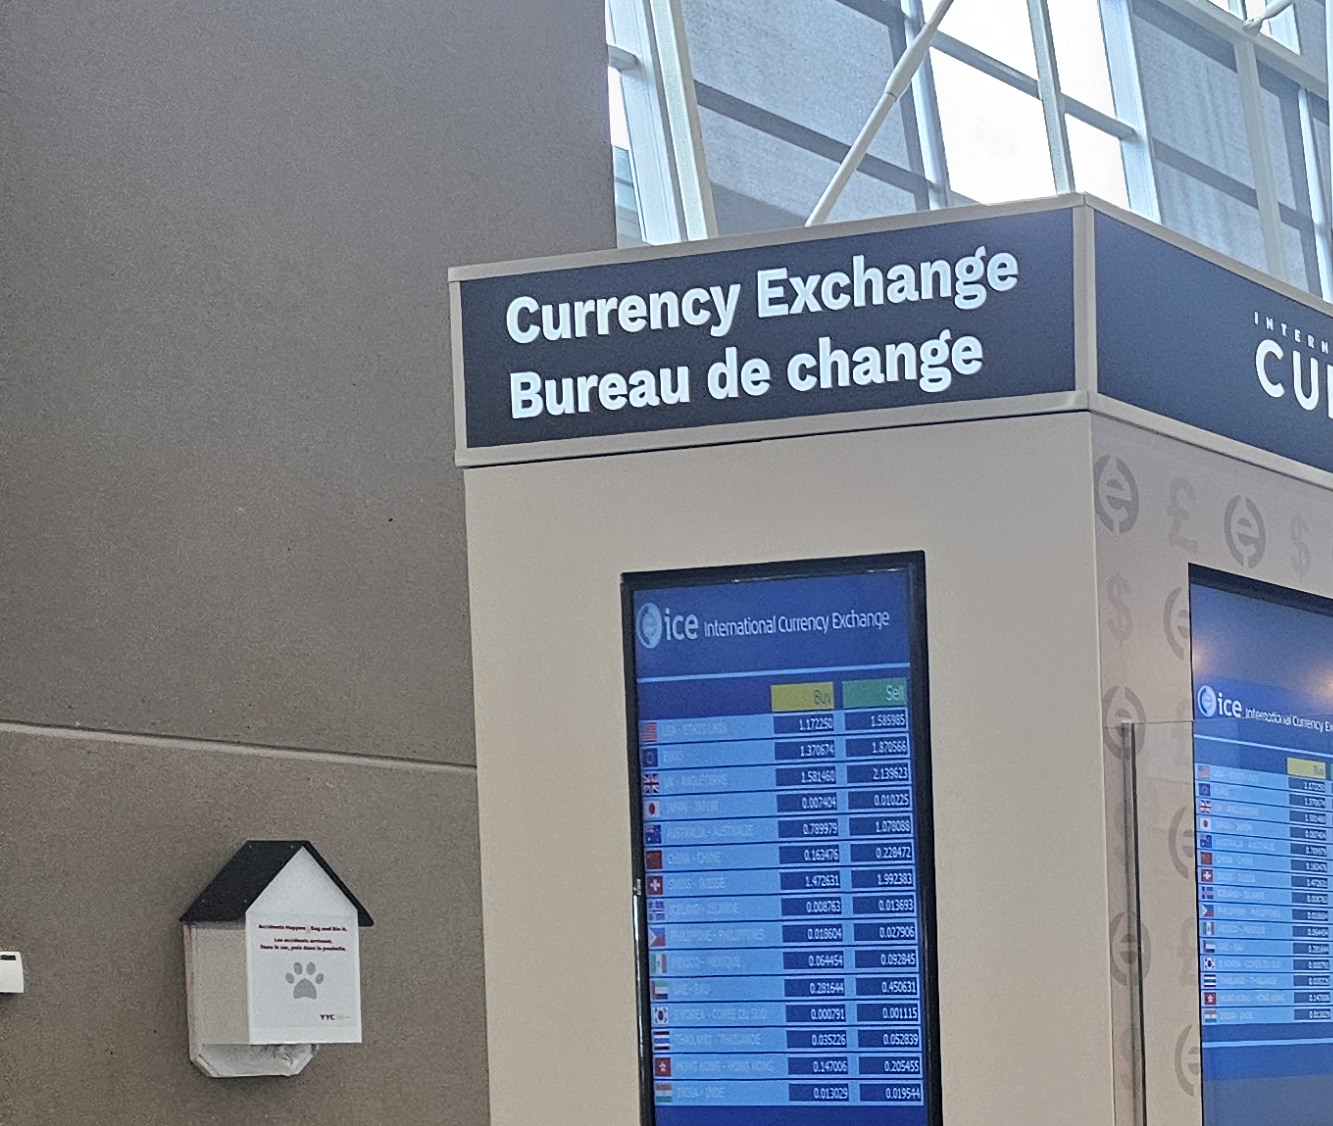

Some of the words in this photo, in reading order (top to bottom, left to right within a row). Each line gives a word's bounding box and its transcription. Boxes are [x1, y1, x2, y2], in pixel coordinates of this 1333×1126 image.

[507, 282, 741, 344] Currency
[756, 245, 1019, 319] Exchange
[509, 366, 690, 419] Bureau
[707, 346, 771, 399] de
[787, 328, 984, 393] change
[664, 607, 699, 641] ice
[703, 616, 777, 638] International
[777, 615, 829, 634] Currency
[832, 609, 890, 630] Exchange
[1218, 692, 1242, 718] ice
[1245, 708, 1293, 726] International
[1292, 716, 1324, 733] Currency
[800, 744, 834, 757] 1.370674
[802, 771, 835, 782] 1.581460
[874, 794, 910, 806] 0.010225
[877, 873, 912, 885] 1.992383
[806, 901, 840, 912] 0.008763
[879, 926, 915, 938] 0.027906
[881, 953, 916, 965] 0.092845
[883, 1007, 917, 1018] 0.001115
[813, 1061, 848, 1073] 0.147006
[814, 1088, 848, 1099] 0.013029
[886, 1087, 920, 1099] 0.019544
